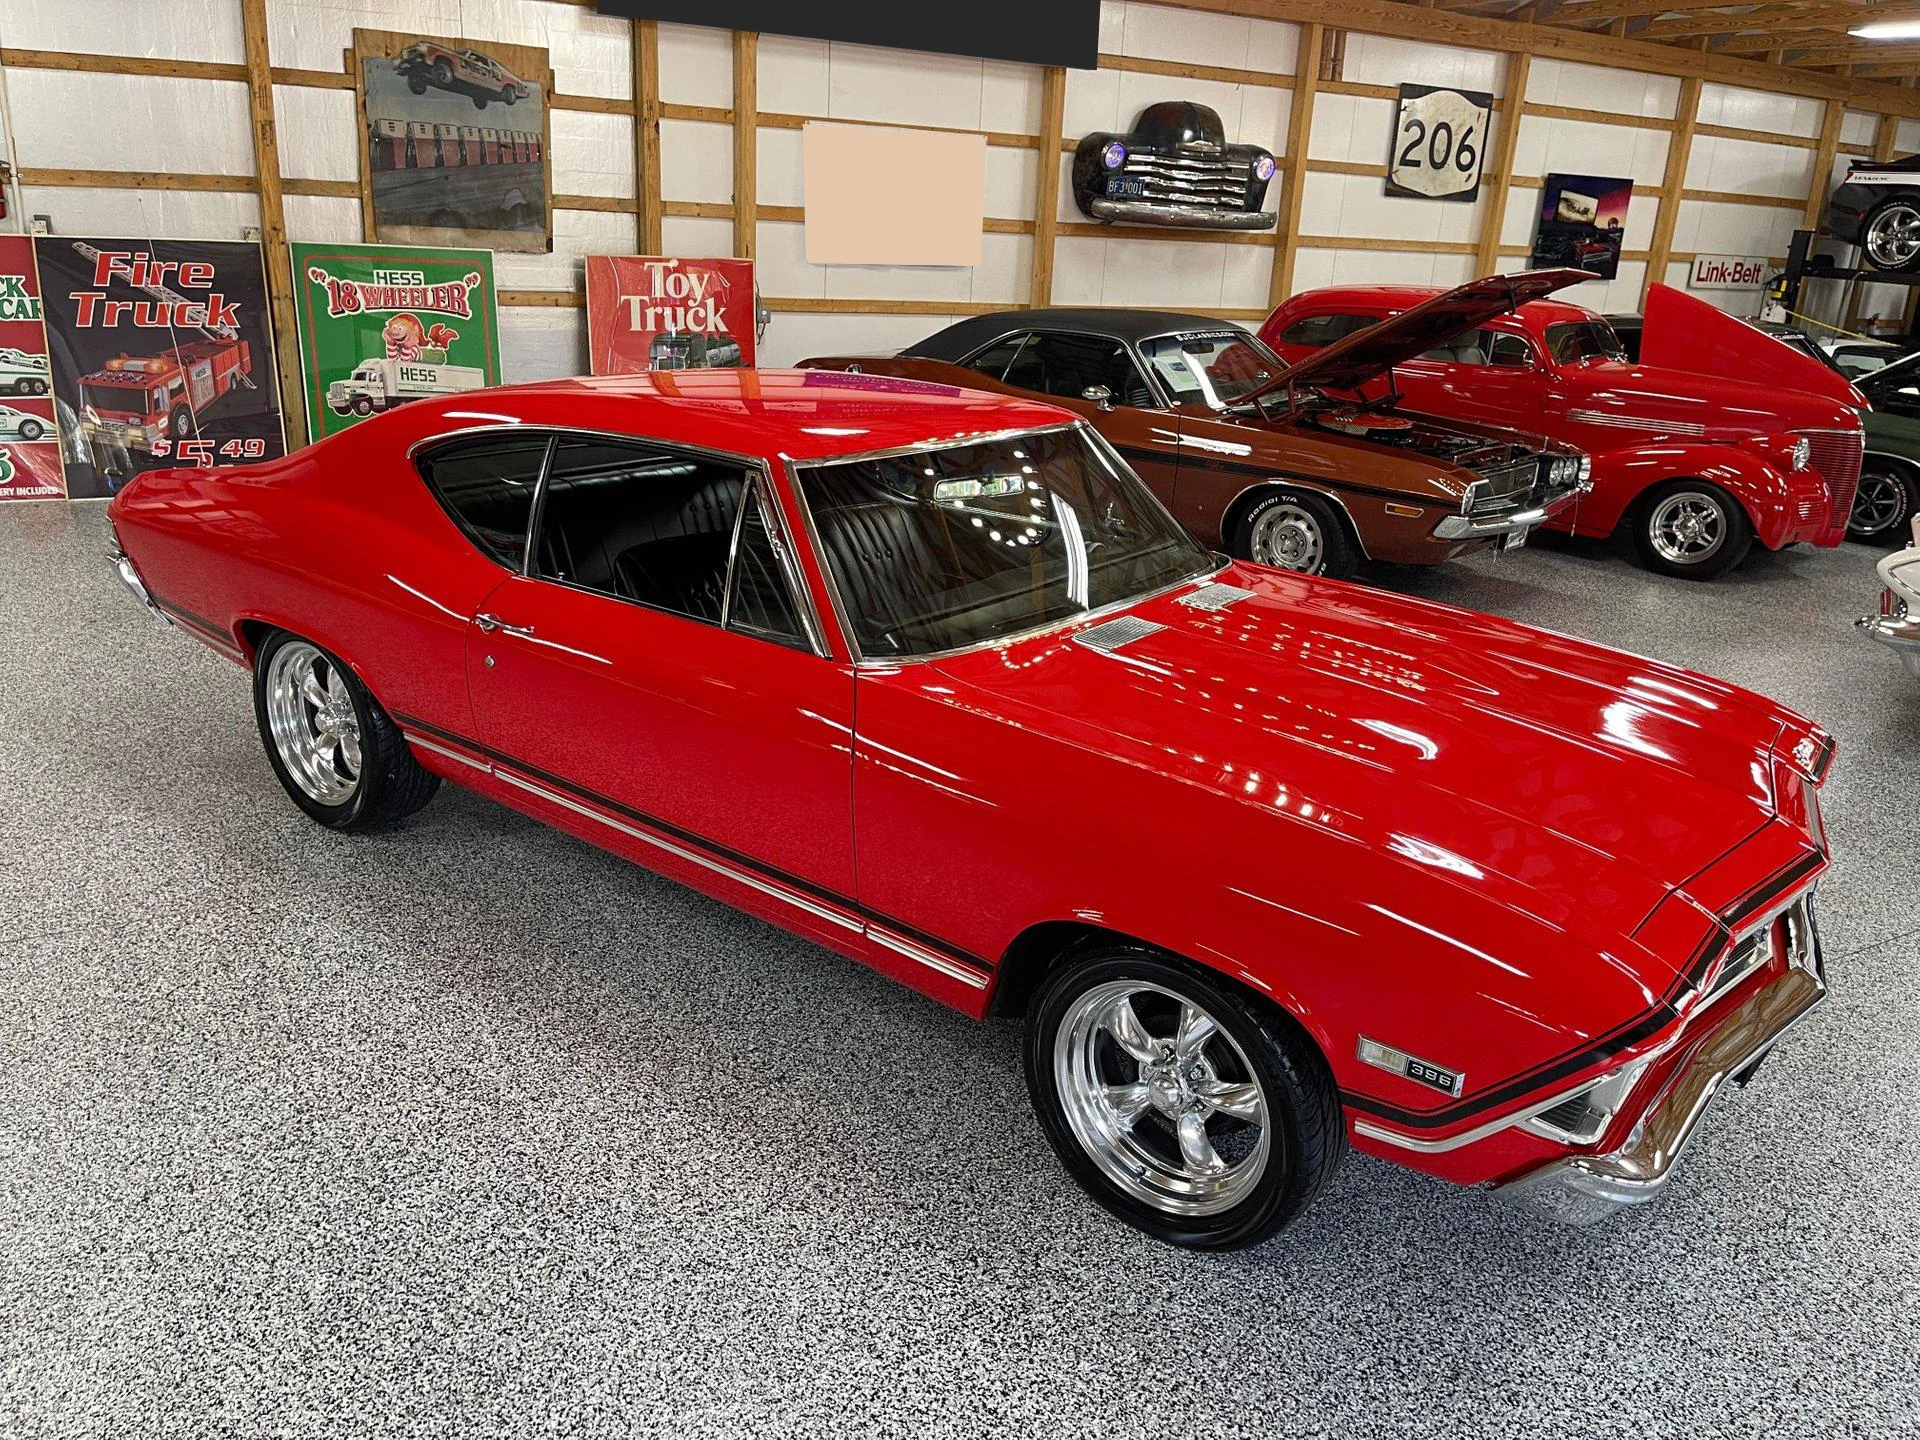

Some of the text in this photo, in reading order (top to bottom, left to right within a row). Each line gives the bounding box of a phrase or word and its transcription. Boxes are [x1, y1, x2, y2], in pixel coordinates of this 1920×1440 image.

[1399, 118, 1477, 173] 206
[93, 251, 215, 288] Fire
[375, 271, 423, 286] HESS
[643, 258, 710, 307] Toy
[1696, 260, 1762, 284] Link-Belt
[69, 293, 242, 328] Truck
[620, 295, 729, 333] Truck
[400, 367, 437, 383] HESS
[16, 486, 59, 497] INCLUDED
[1247, 495, 1298, 523] Radial T/A
[1411, 1063, 1451, 1086] 396
